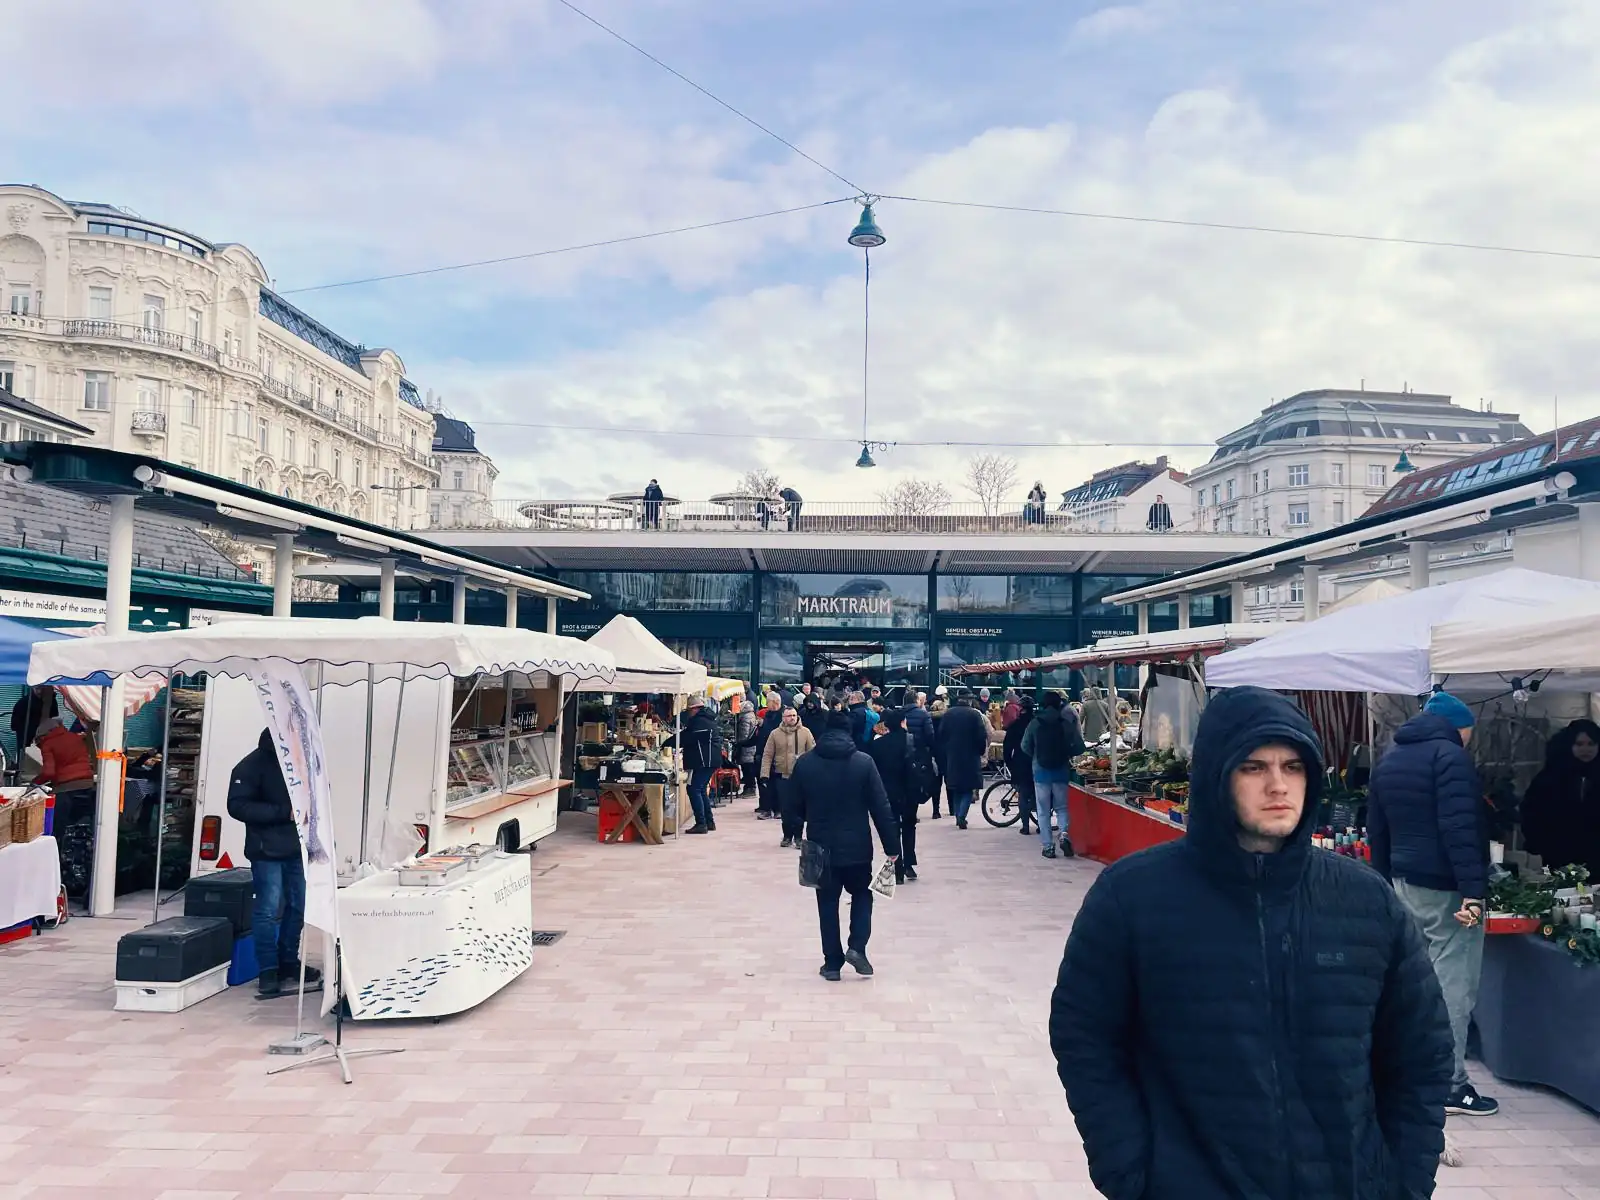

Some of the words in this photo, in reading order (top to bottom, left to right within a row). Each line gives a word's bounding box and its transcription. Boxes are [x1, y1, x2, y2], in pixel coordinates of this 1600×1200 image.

[14, 597, 21, 607] in
[23, 598, 34, 609] the
[36, 600, 59, 611] middle
[60, 602, 68, 611] of
[69, 603, 79, 612] the
[798, 597, 892, 614] MARKTRAUM
